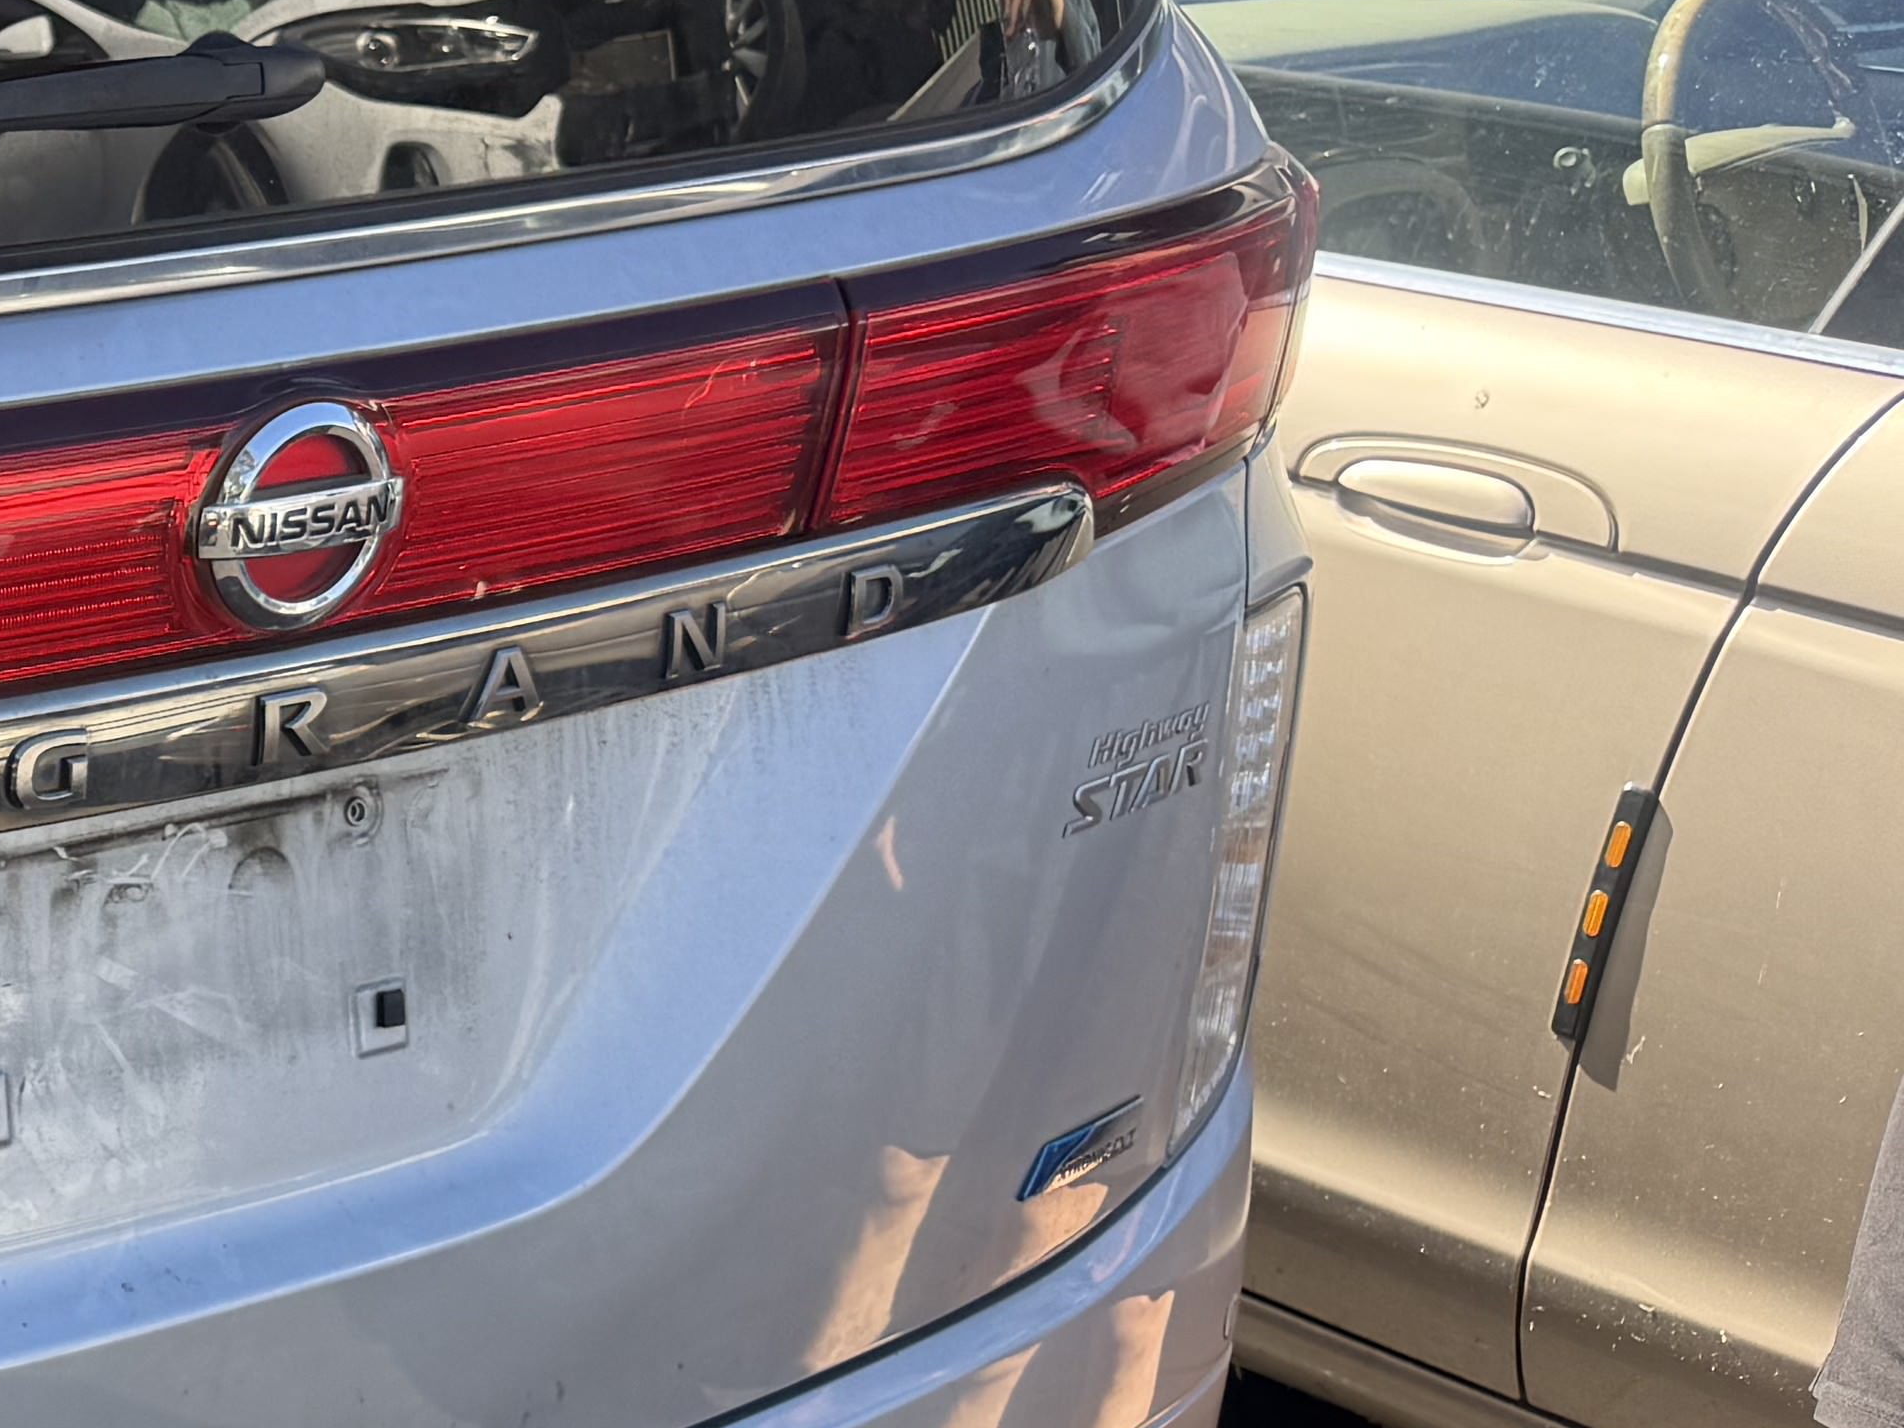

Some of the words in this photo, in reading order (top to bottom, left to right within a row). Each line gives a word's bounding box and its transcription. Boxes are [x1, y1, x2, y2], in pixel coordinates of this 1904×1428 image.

[229, 492, 390, 549] NISSAN
[1087, 700, 1210, 770] Highway
[1061, 737, 1209, 839] STAR
